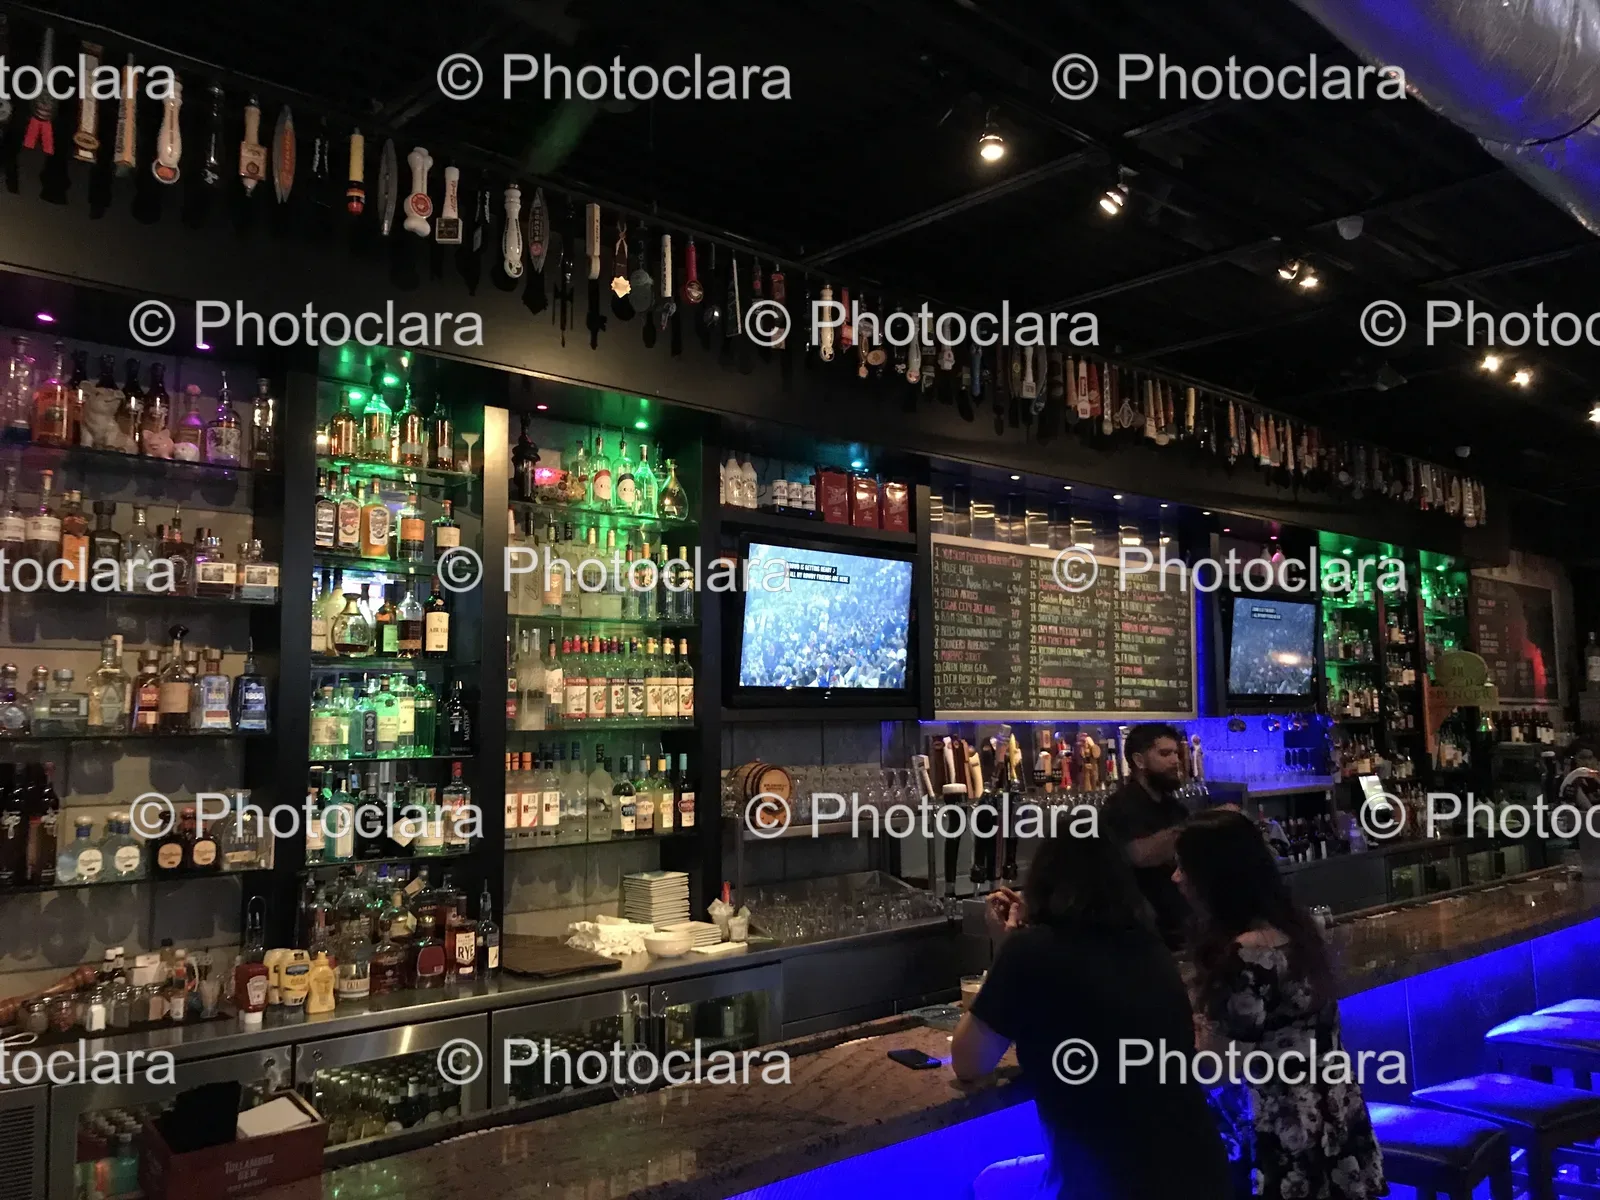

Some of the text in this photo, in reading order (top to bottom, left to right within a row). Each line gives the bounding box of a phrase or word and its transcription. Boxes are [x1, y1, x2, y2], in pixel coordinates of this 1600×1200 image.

[245, 692, 264, 700] 1800
[458, 945, 475, 960] RYE
[224, 1153, 276, 1175] TULLAMORE
[237, 1168, 260, 1181] DEW
